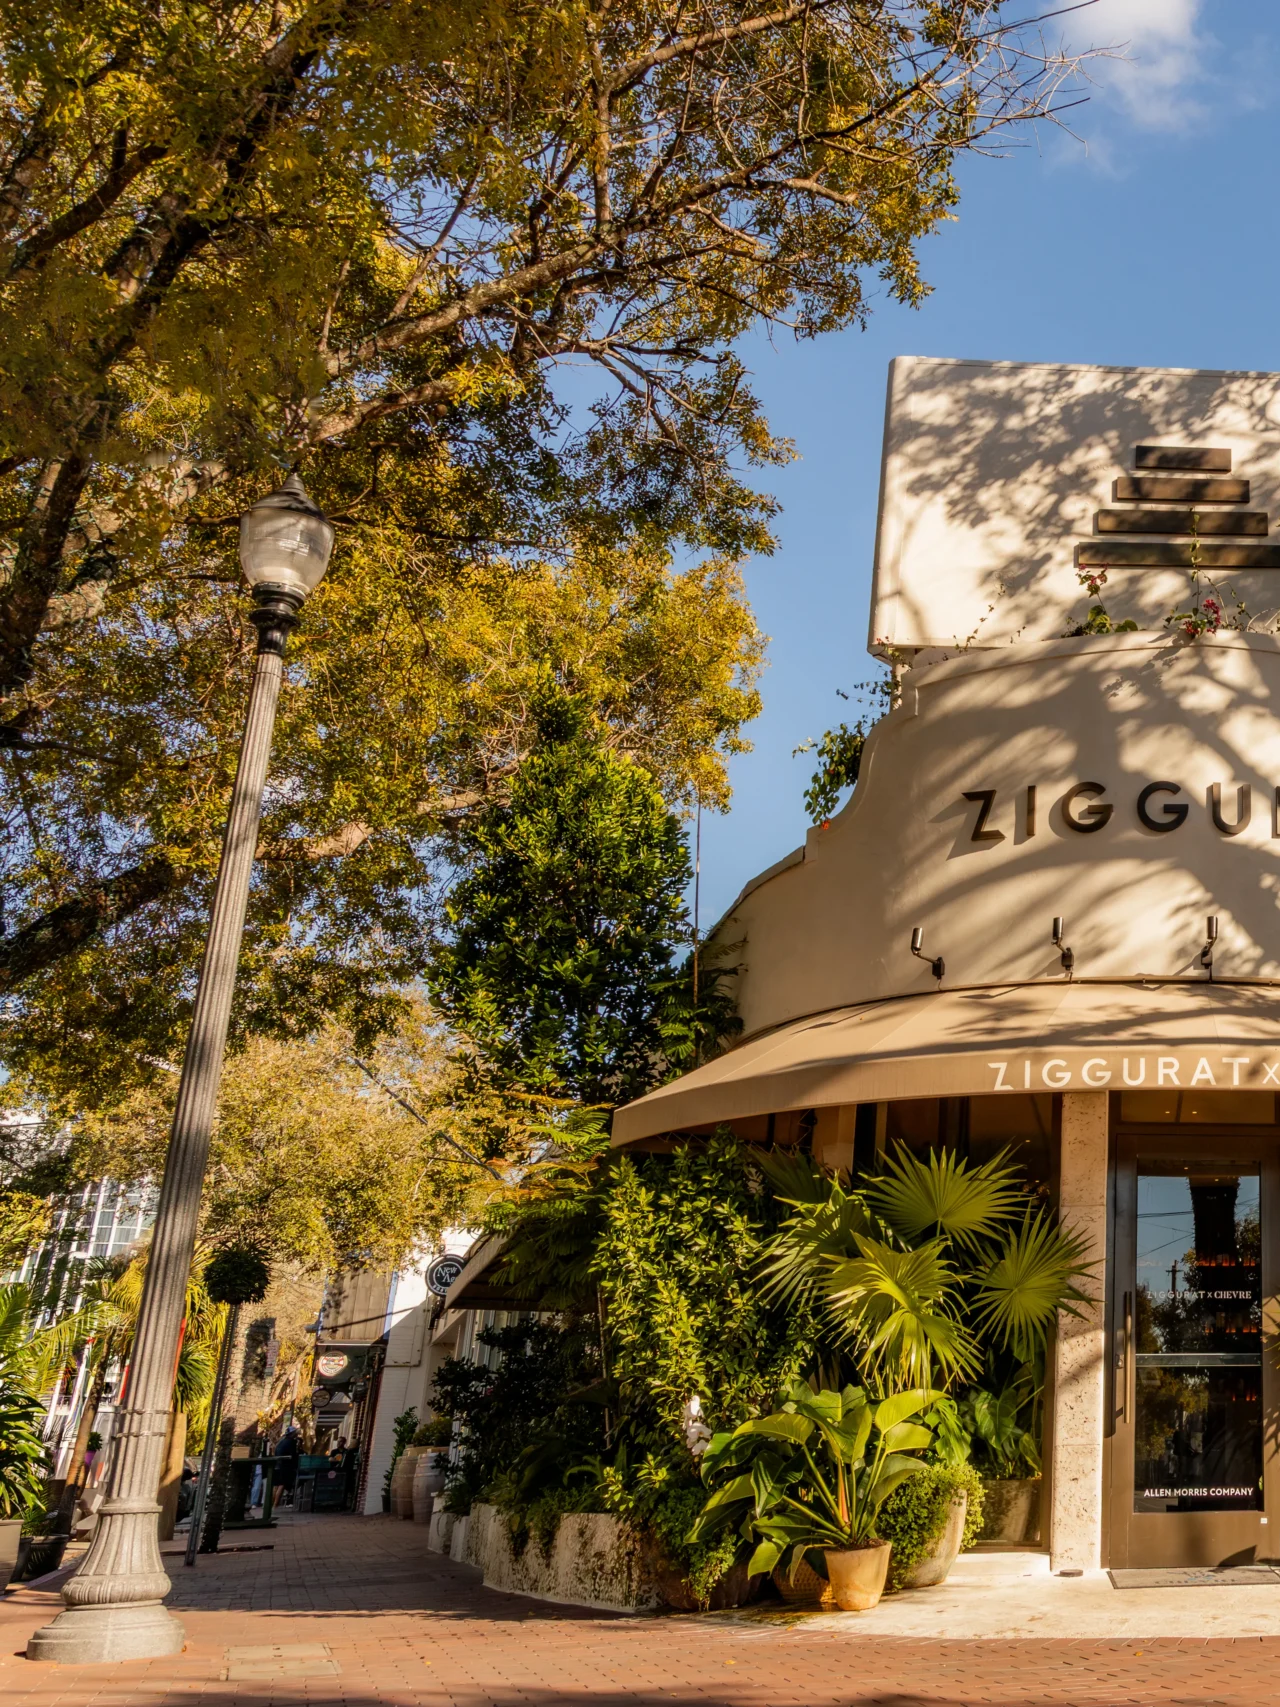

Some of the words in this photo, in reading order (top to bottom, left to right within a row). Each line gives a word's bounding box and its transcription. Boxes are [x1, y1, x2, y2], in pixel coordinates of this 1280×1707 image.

[987, 1057, 1250, 1091] ZIGGURAT
[1147, 1290, 1205, 1299] ZIGGURAT
[1144, 1488, 1172, 1497] ALLEN
[1174, 1487, 1208, 1497] MORRIS
[1209, 1487, 1254, 1496] COMPANY
